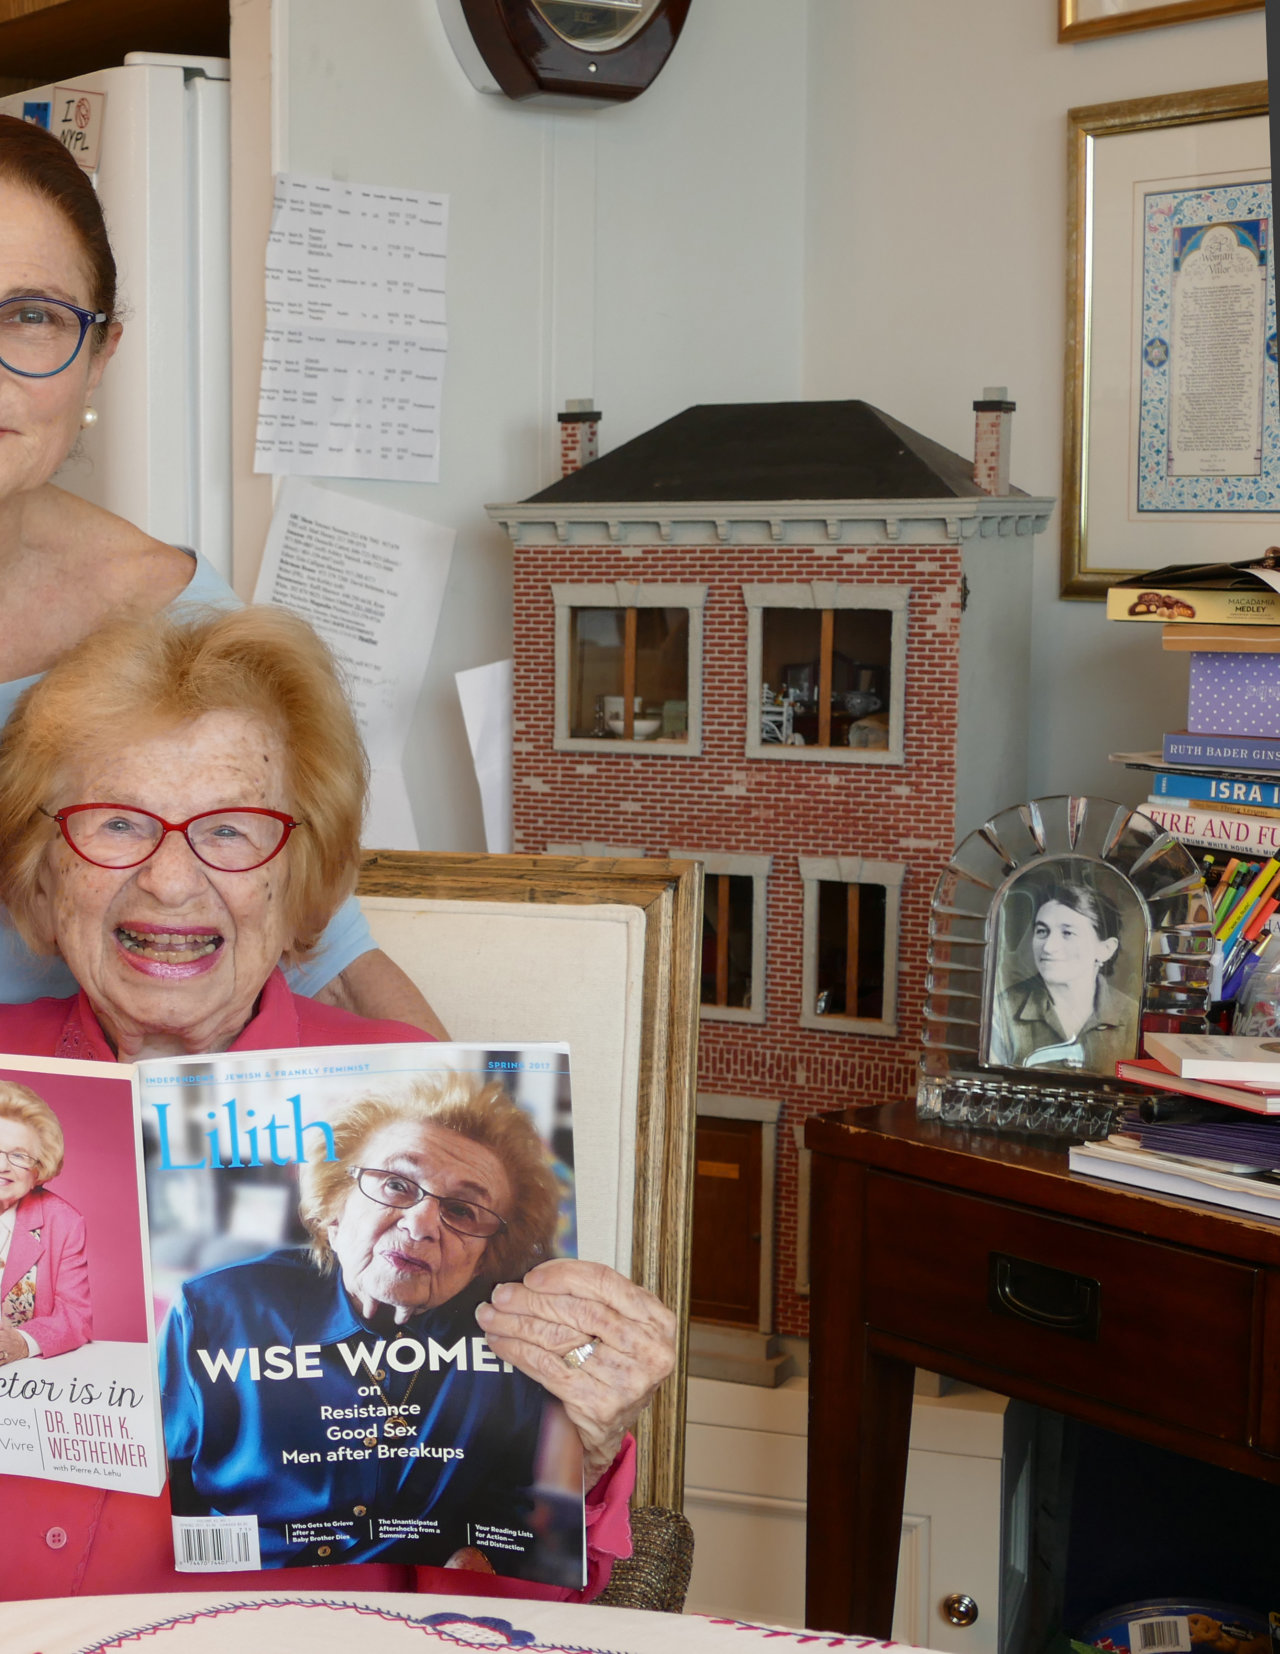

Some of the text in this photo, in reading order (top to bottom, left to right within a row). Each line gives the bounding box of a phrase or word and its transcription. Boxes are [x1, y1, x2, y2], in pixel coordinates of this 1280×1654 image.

[61, 100, 75, 122] I
[61, 129, 89, 152] NYPL
[1228, 598, 1276, 606] MACADAMIA
[1235, 605, 1266, 613] MEDLEY
[1170, 744, 1202, 756] RUTH
[1206, 747, 1248, 760] BADER
[1210, 780, 1263, 802] ISRA
[1149, 810, 1196, 836] FIRE
[1202, 818, 1250, 843] AND
[1182, 837, 1205, 846] TRUMP
[1207, 841, 1228, 850] WHITE
[1231, 844, 1254, 853] HOUSE
[224, 1069, 263, 1081] JEWISH
[264, 1069, 273, 1079] &
[274, 1066, 320, 1078] FRANKLY
[323, 1063, 371, 1075] FEMINIST
[488, 1060, 551, 1070] SPRING 2017
[151, 1094, 341, 1171] Lilith
[197, 1336, 514, 1383] WISE WOME
[68, 1377, 103, 1405] is
[108, 1380, 144, 1408] in
[357, 1384, 381, 1397] on
[320, 1403, 421, 1420] Resistance
[44, 1410, 134, 1440] DR. RUTH K.
[326, 1422, 418, 1441] Good Sex
[0, 1437, 34, 1451] Vivre
[47, 1437, 148, 1468] WESTHEIMER
[282, 1443, 464, 1465] Men after Breakups
[53, 1464, 122, 1478] with Pierre A. Lehu
[307, 1521, 323, 1529] Gets
[332, 1520, 354, 1528] Grieve
[378, 1525, 418, 1533] Aftershocks
[419, 1526, 435, 1534] from
[392, 1518, 438, 1527] Unanticipated
[292, 1536, 309, 1544] Baby
[310, 1534, 335, 1542] Brother
[475, 1524, 534, 1538] Your Reading Lists
[475, 1531, 486, 1539] for
[490, 1540, 525, 1552] Distraction
